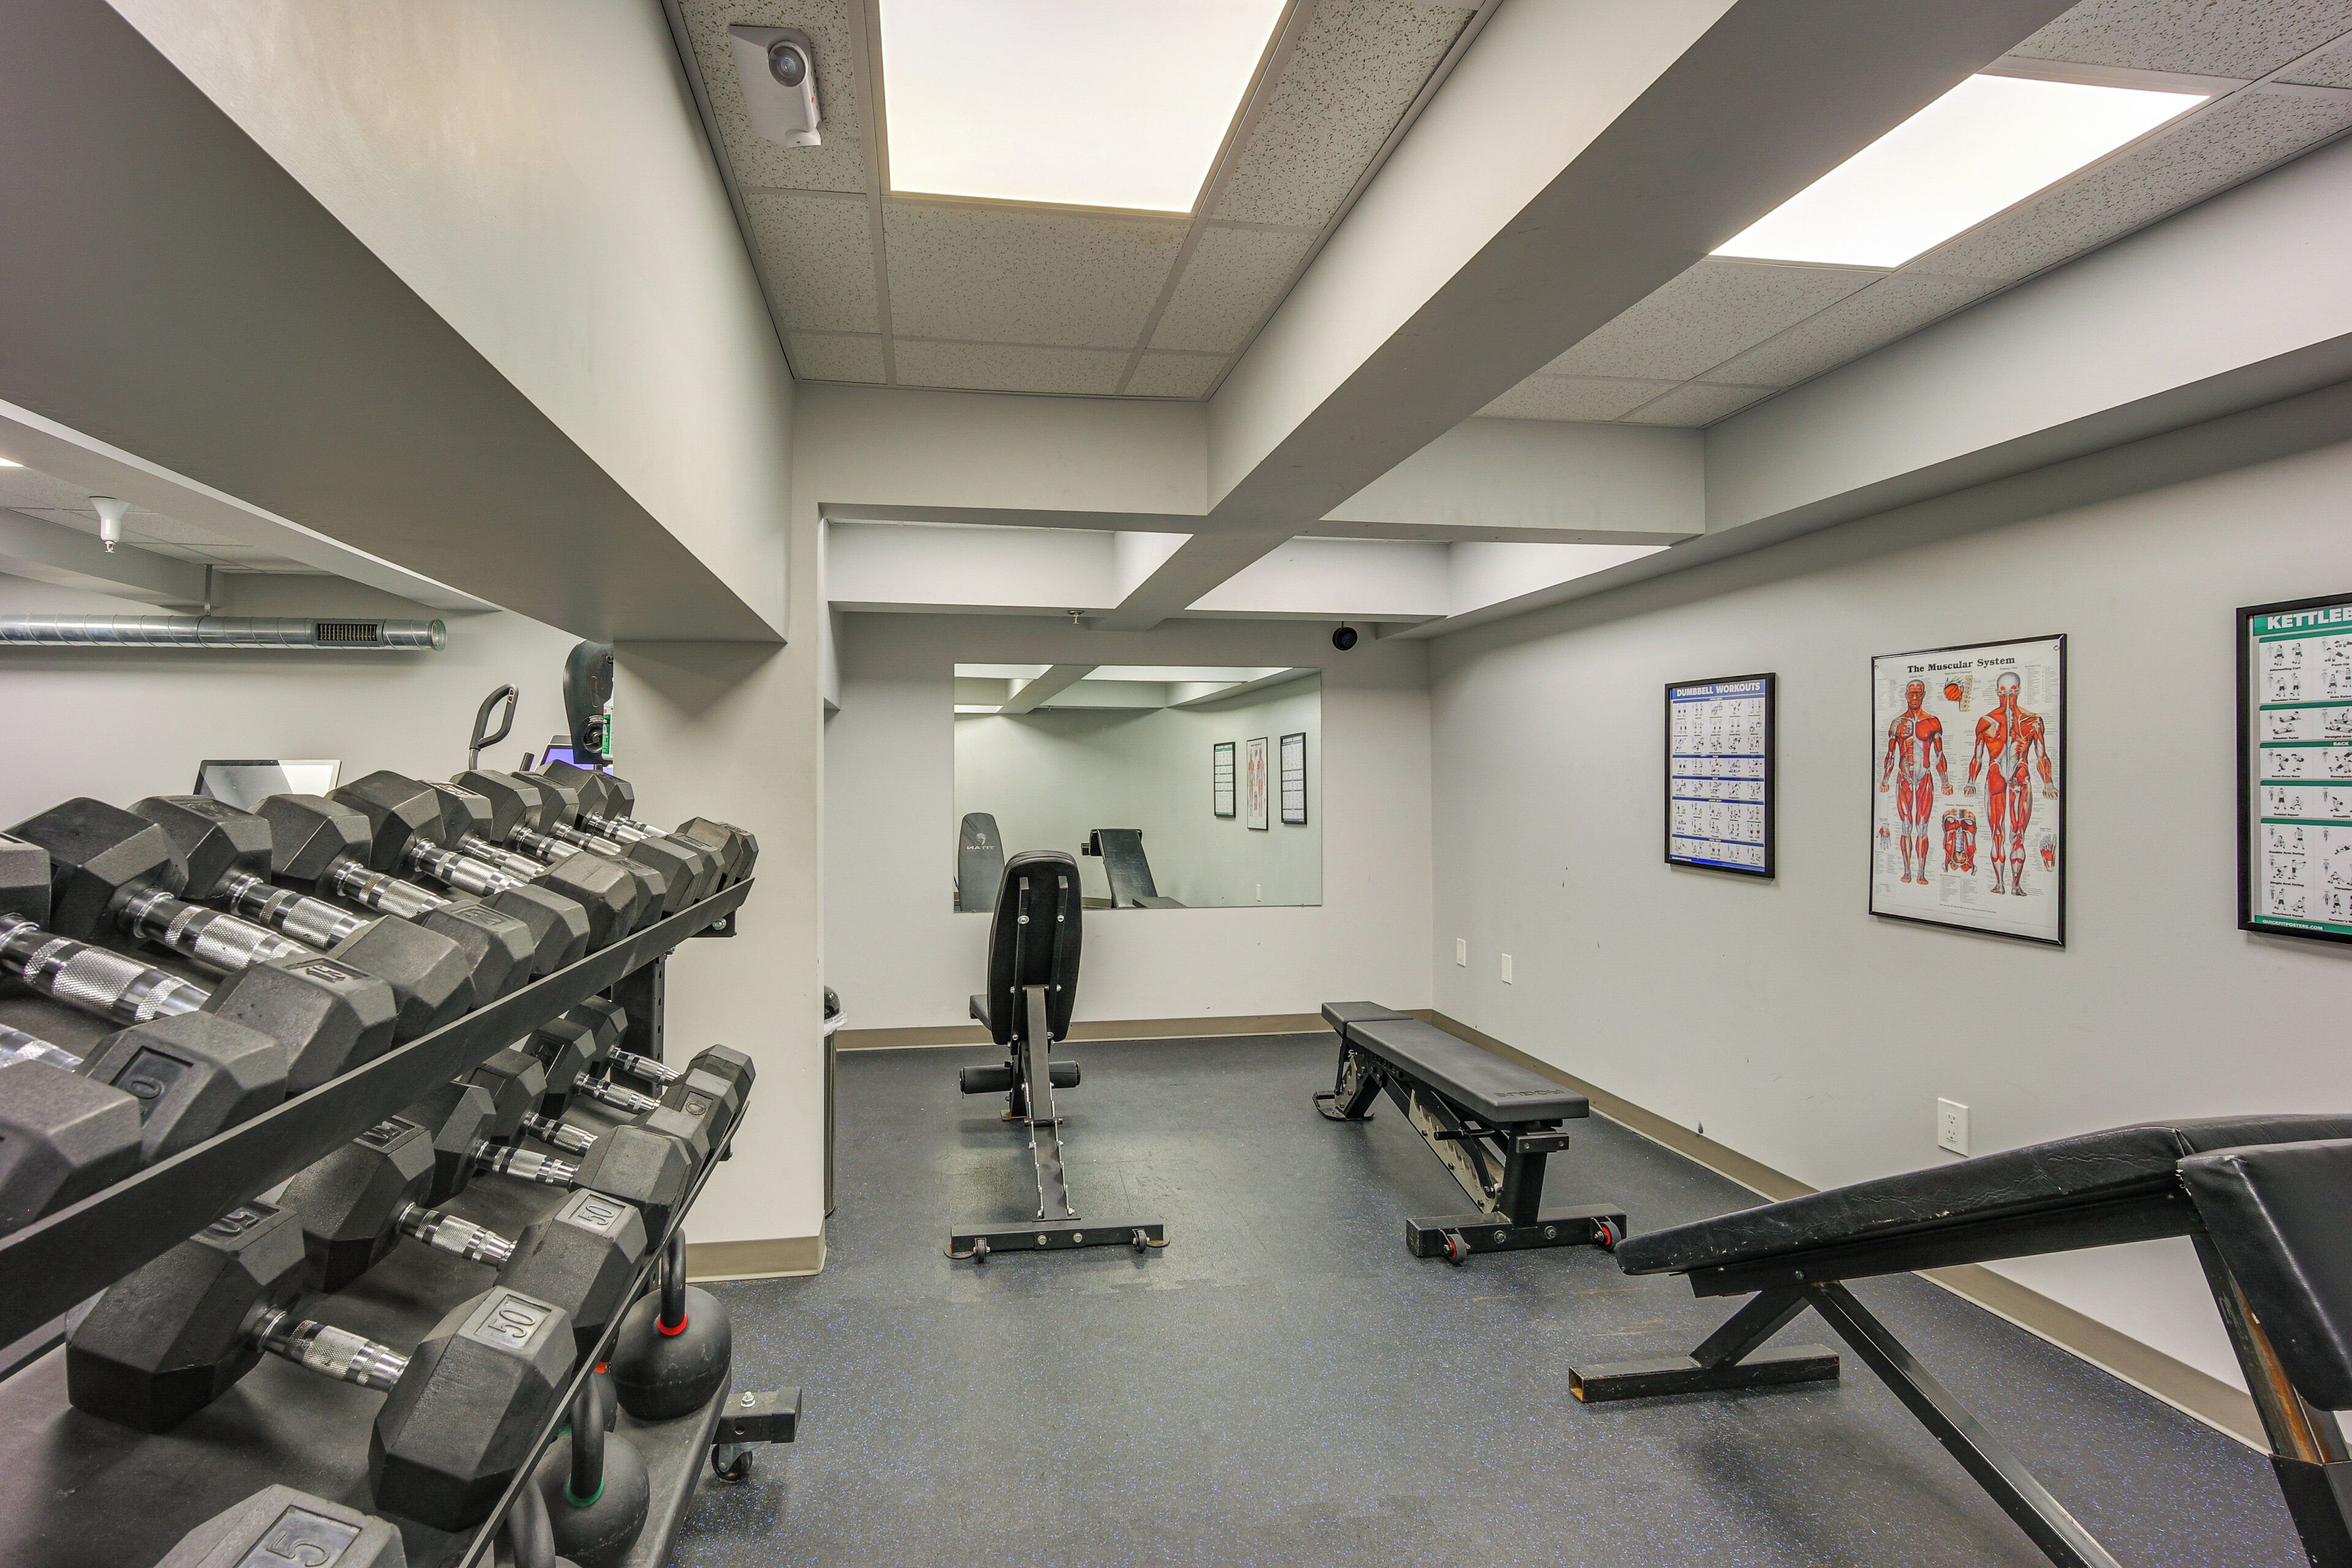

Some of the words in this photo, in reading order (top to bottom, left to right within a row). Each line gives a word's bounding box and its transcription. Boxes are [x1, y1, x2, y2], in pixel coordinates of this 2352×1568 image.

[2267, 607, 2352, 630] KETTLEB
[1928, 661, 1973, 671] Muscular
[1977, 657, 2015, 668] System
[1676, 686, 1714, 697] DUMBBELL
[1716, 682, 1761, 694] WORKOUTS
[2262, 919, 2323, 930] QUICKFITPOSTERS.COM
[130, 1075, 164, 1101] 0
[685, 1101, 706, 1115] 0
[578, 1205, 615, 1226] 50
[488, 1310, 536, 1338] 50
